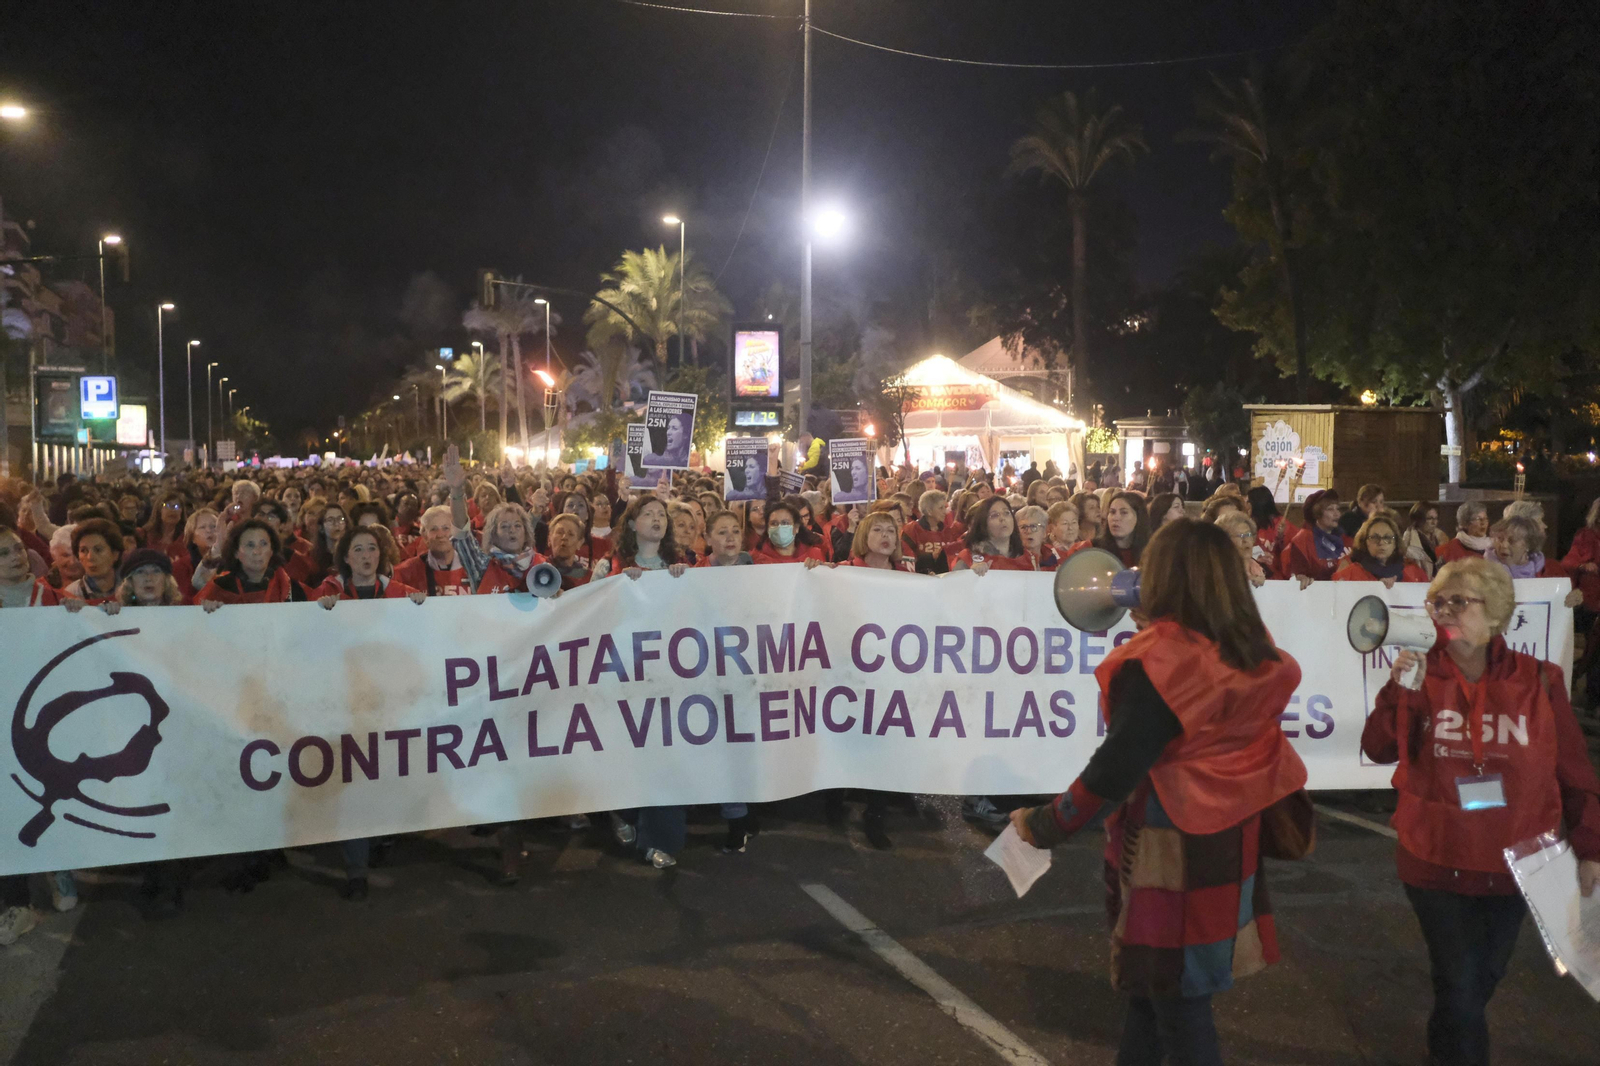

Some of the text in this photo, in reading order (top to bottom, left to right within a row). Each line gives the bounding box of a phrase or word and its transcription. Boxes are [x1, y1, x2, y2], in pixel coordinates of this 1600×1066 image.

[87, 380, 109, 402] P
[912, 398, 967, 409] COMACOR
[648, 418, 666, 428] 25N
[1265, 437, 1292, 455] cajón
[727, 459, 744, 468] 25N
[832, 462, 850, 470] 25N
[445, 621, 831, 707] PLATAFORMA
[239, 717, 508, 791] CONTRA
[528, 703, 603, 758] LA
[617, 686, 915, 748] VIOLENCIA
[929, 691, 967, 738] A
[984, 690, 1076, 738] LAS
